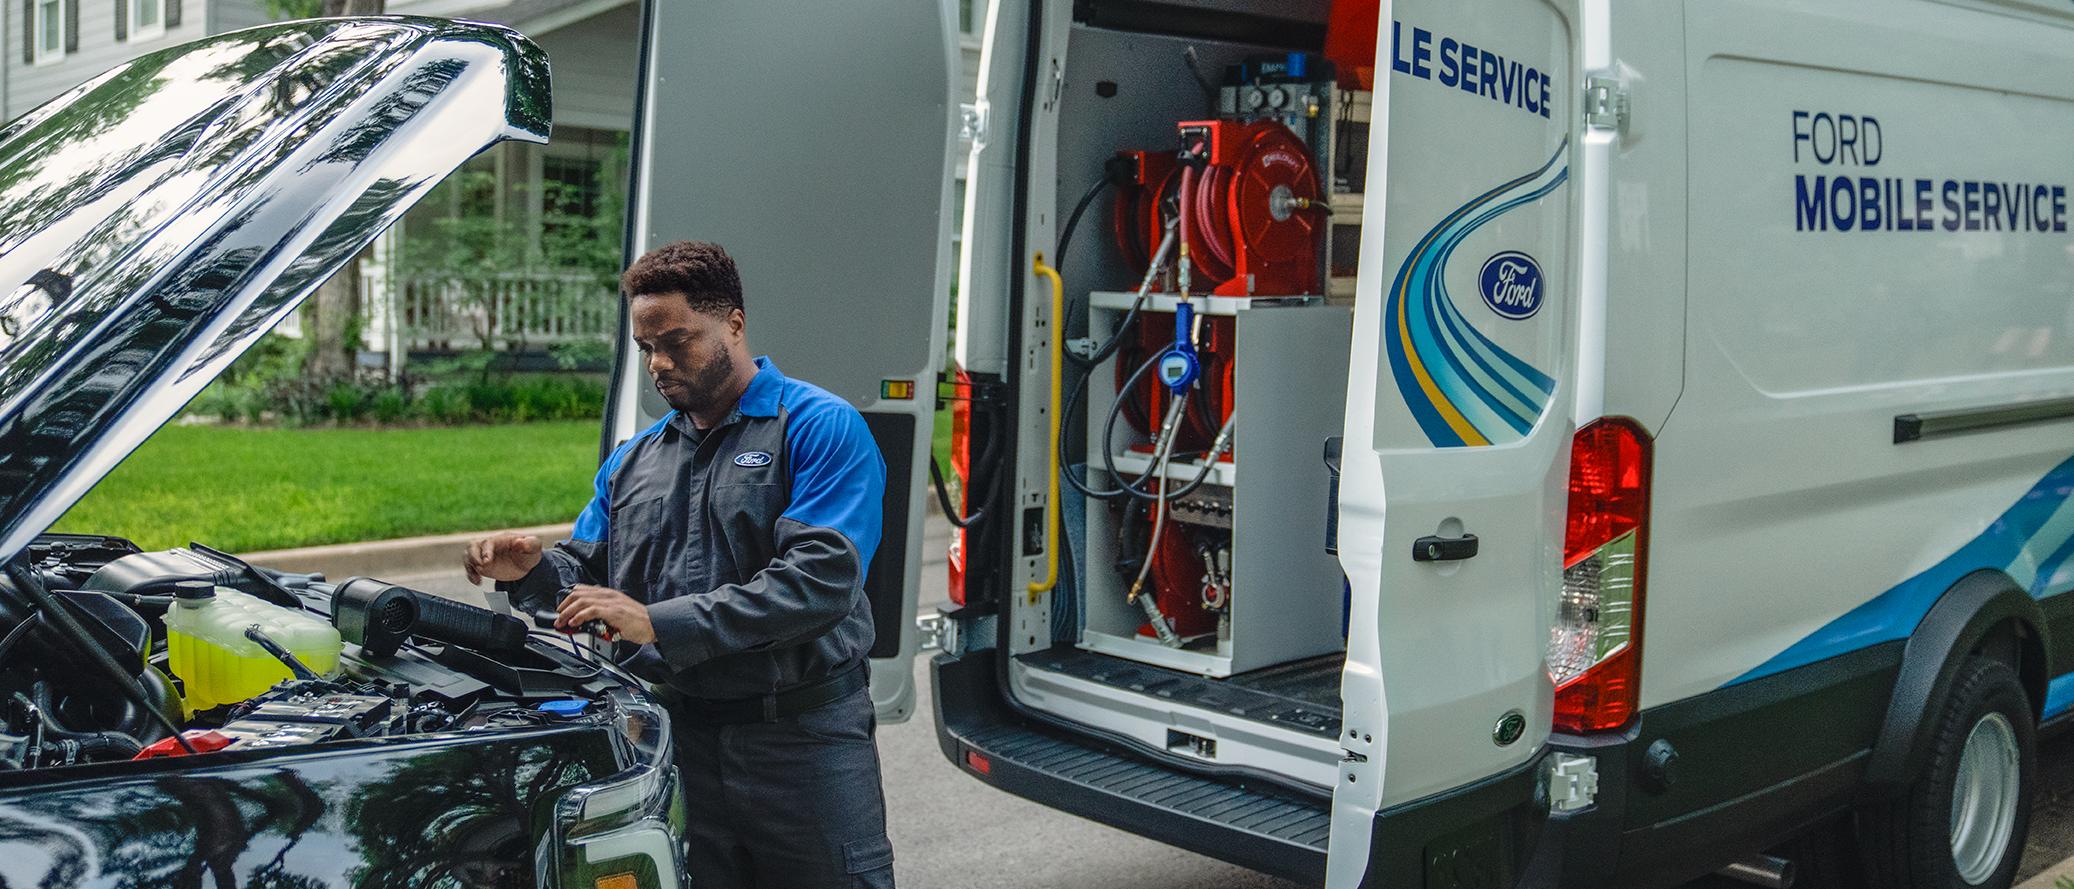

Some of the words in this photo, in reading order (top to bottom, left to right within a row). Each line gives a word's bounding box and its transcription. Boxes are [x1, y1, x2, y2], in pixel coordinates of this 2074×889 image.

[1392, 20, 1432, 80] LE
[1438, 37, 1551, 119] SERVICE
[1792, 110, 1882, 166] FORD
[1795, 174, 1934, 232] MOBILE
[1942, 179, 2067, 232] SERVICE
[1493, 261, 1536, 308] Ford
[740, 453, 765, 465] Ford
